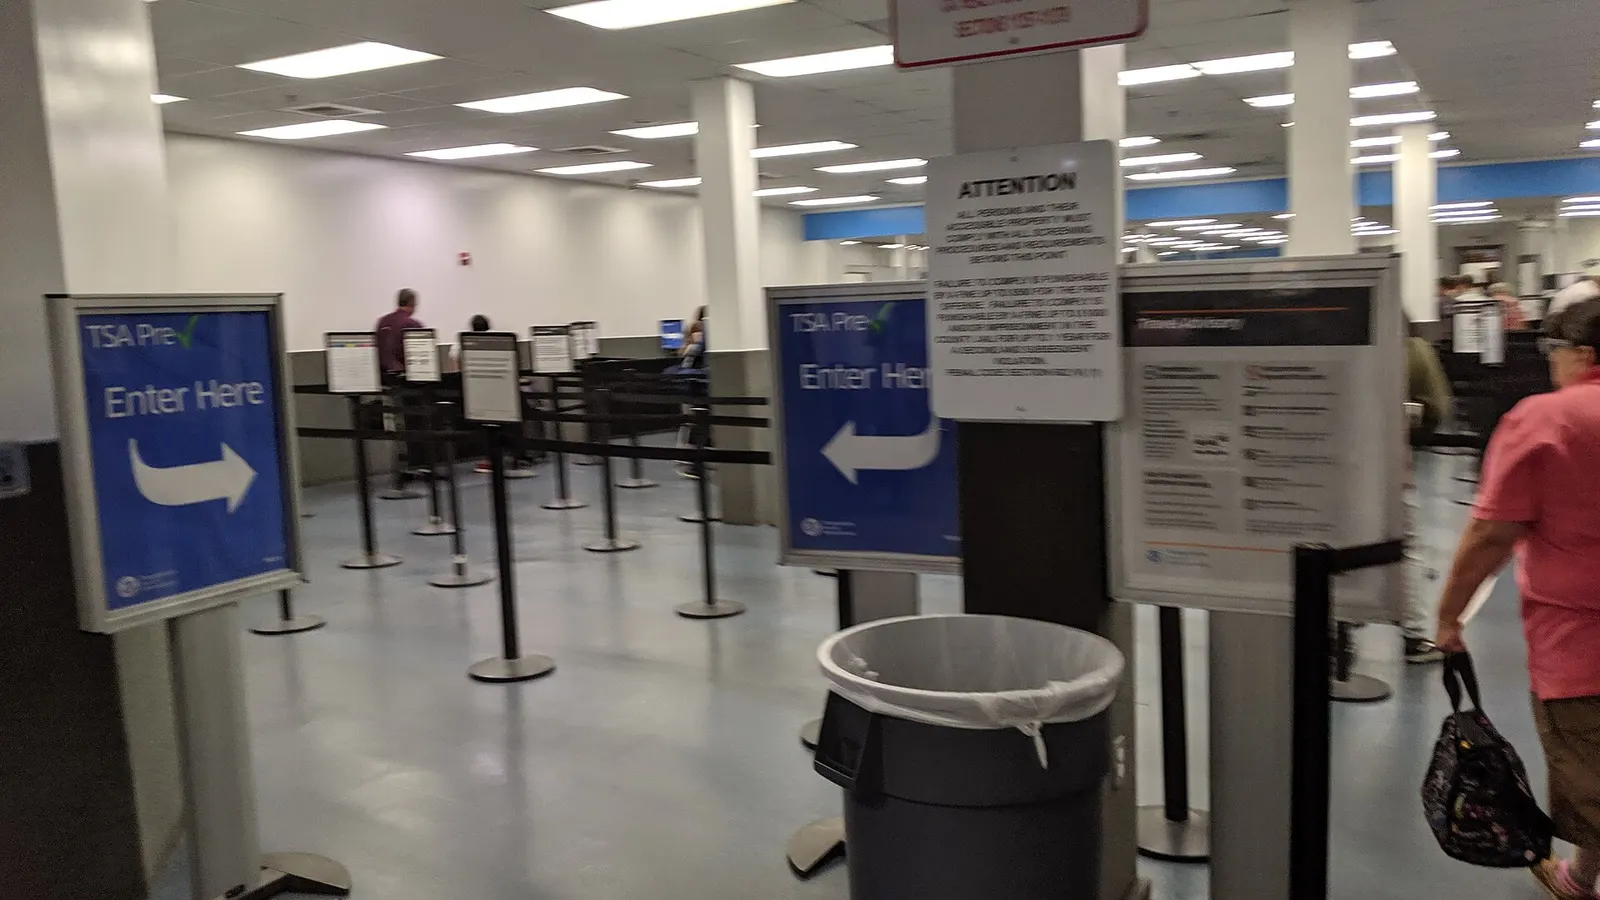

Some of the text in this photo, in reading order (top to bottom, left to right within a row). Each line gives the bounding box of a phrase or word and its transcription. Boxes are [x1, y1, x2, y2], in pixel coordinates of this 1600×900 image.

[957, 172, 1077, 199] ATTENTION
[85, 323, 177, 348] TSA Pre
[788, 312, 870, 332] TSA Pre
[799, 362, 932, 390] Enter Her
[105, 379, 265, 418] Enter Here
